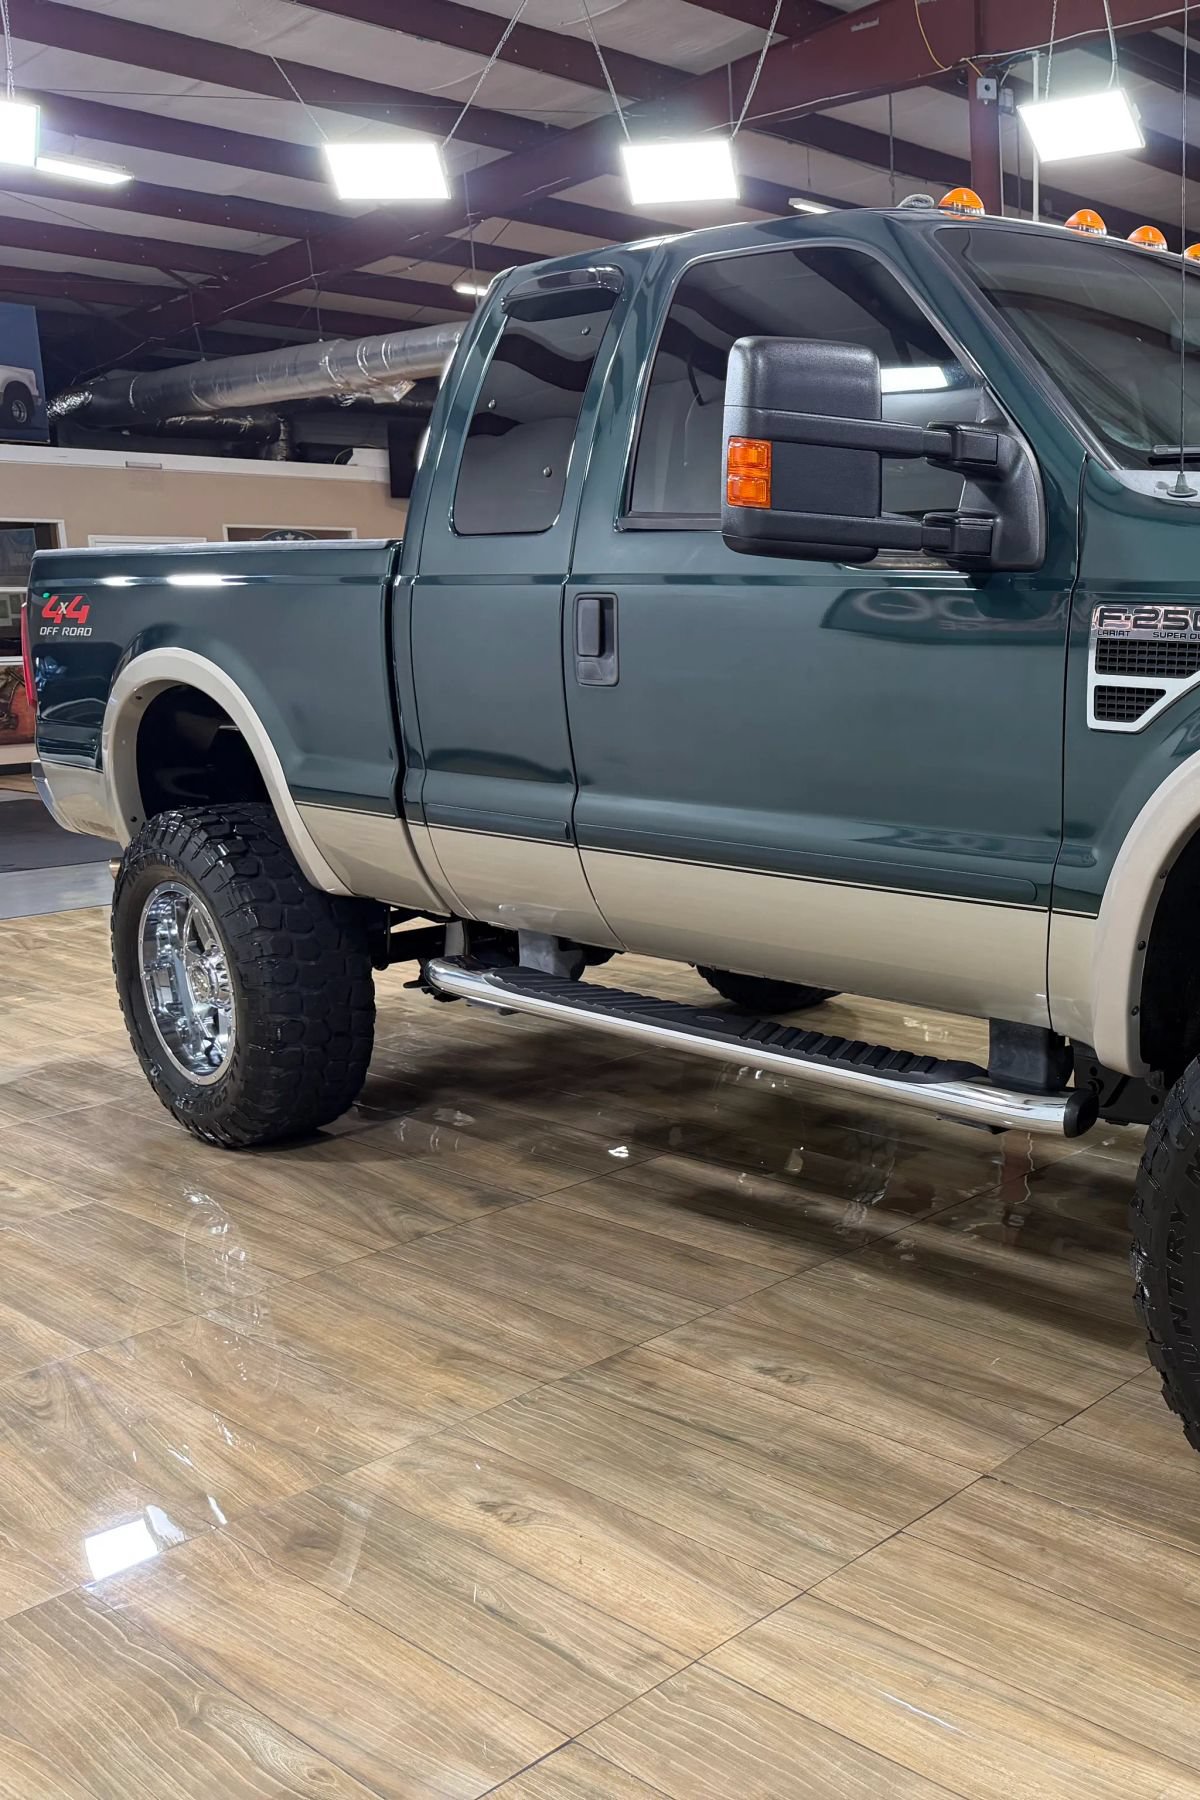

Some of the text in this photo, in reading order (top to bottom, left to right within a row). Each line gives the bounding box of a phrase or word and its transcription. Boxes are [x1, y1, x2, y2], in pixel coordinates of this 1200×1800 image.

[40, 627, 92, 637] OFF ROAD
[1152, 631, 1187, 640] SUPER
